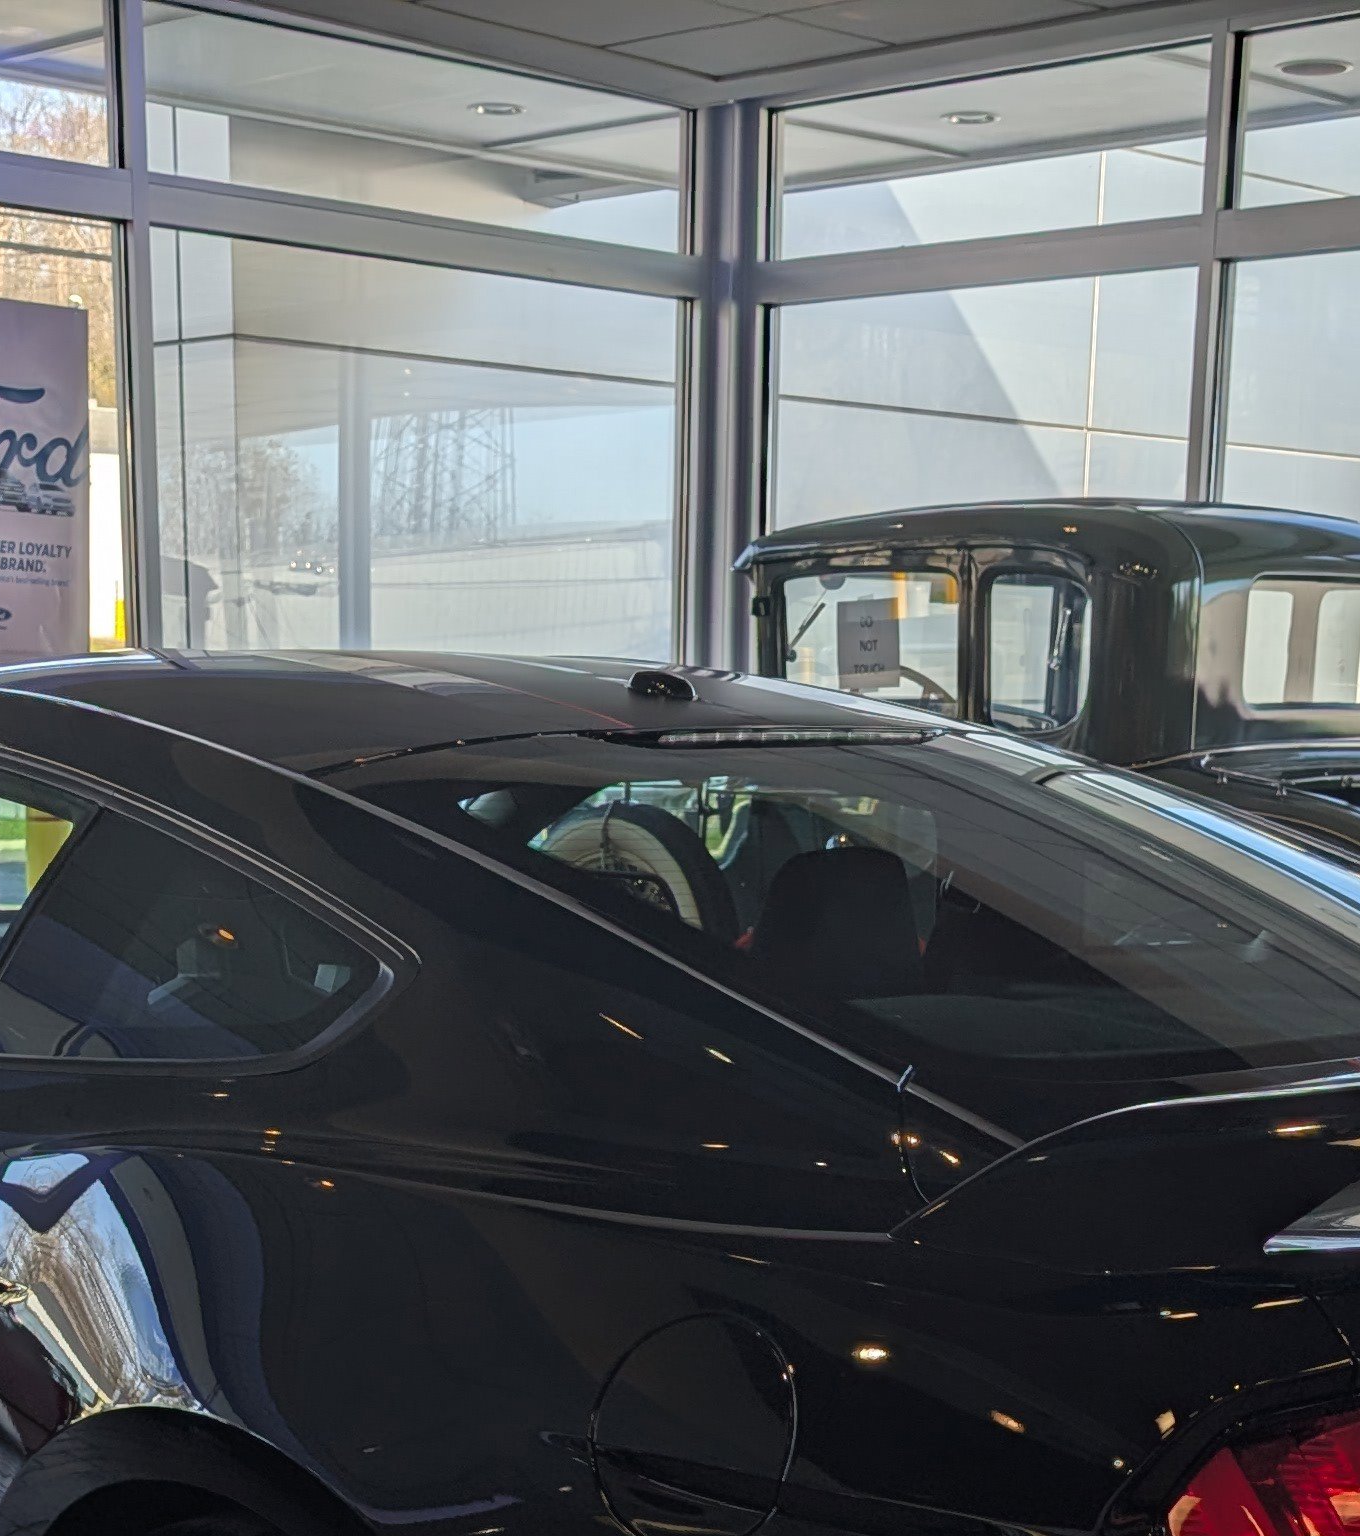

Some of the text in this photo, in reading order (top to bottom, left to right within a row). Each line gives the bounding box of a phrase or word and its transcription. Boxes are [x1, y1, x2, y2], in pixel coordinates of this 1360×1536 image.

[19, 541, 72, 559] LOYALTY
[0, 557, 47, 573] BRAND.
[859, 639, 878, 652] NOT
